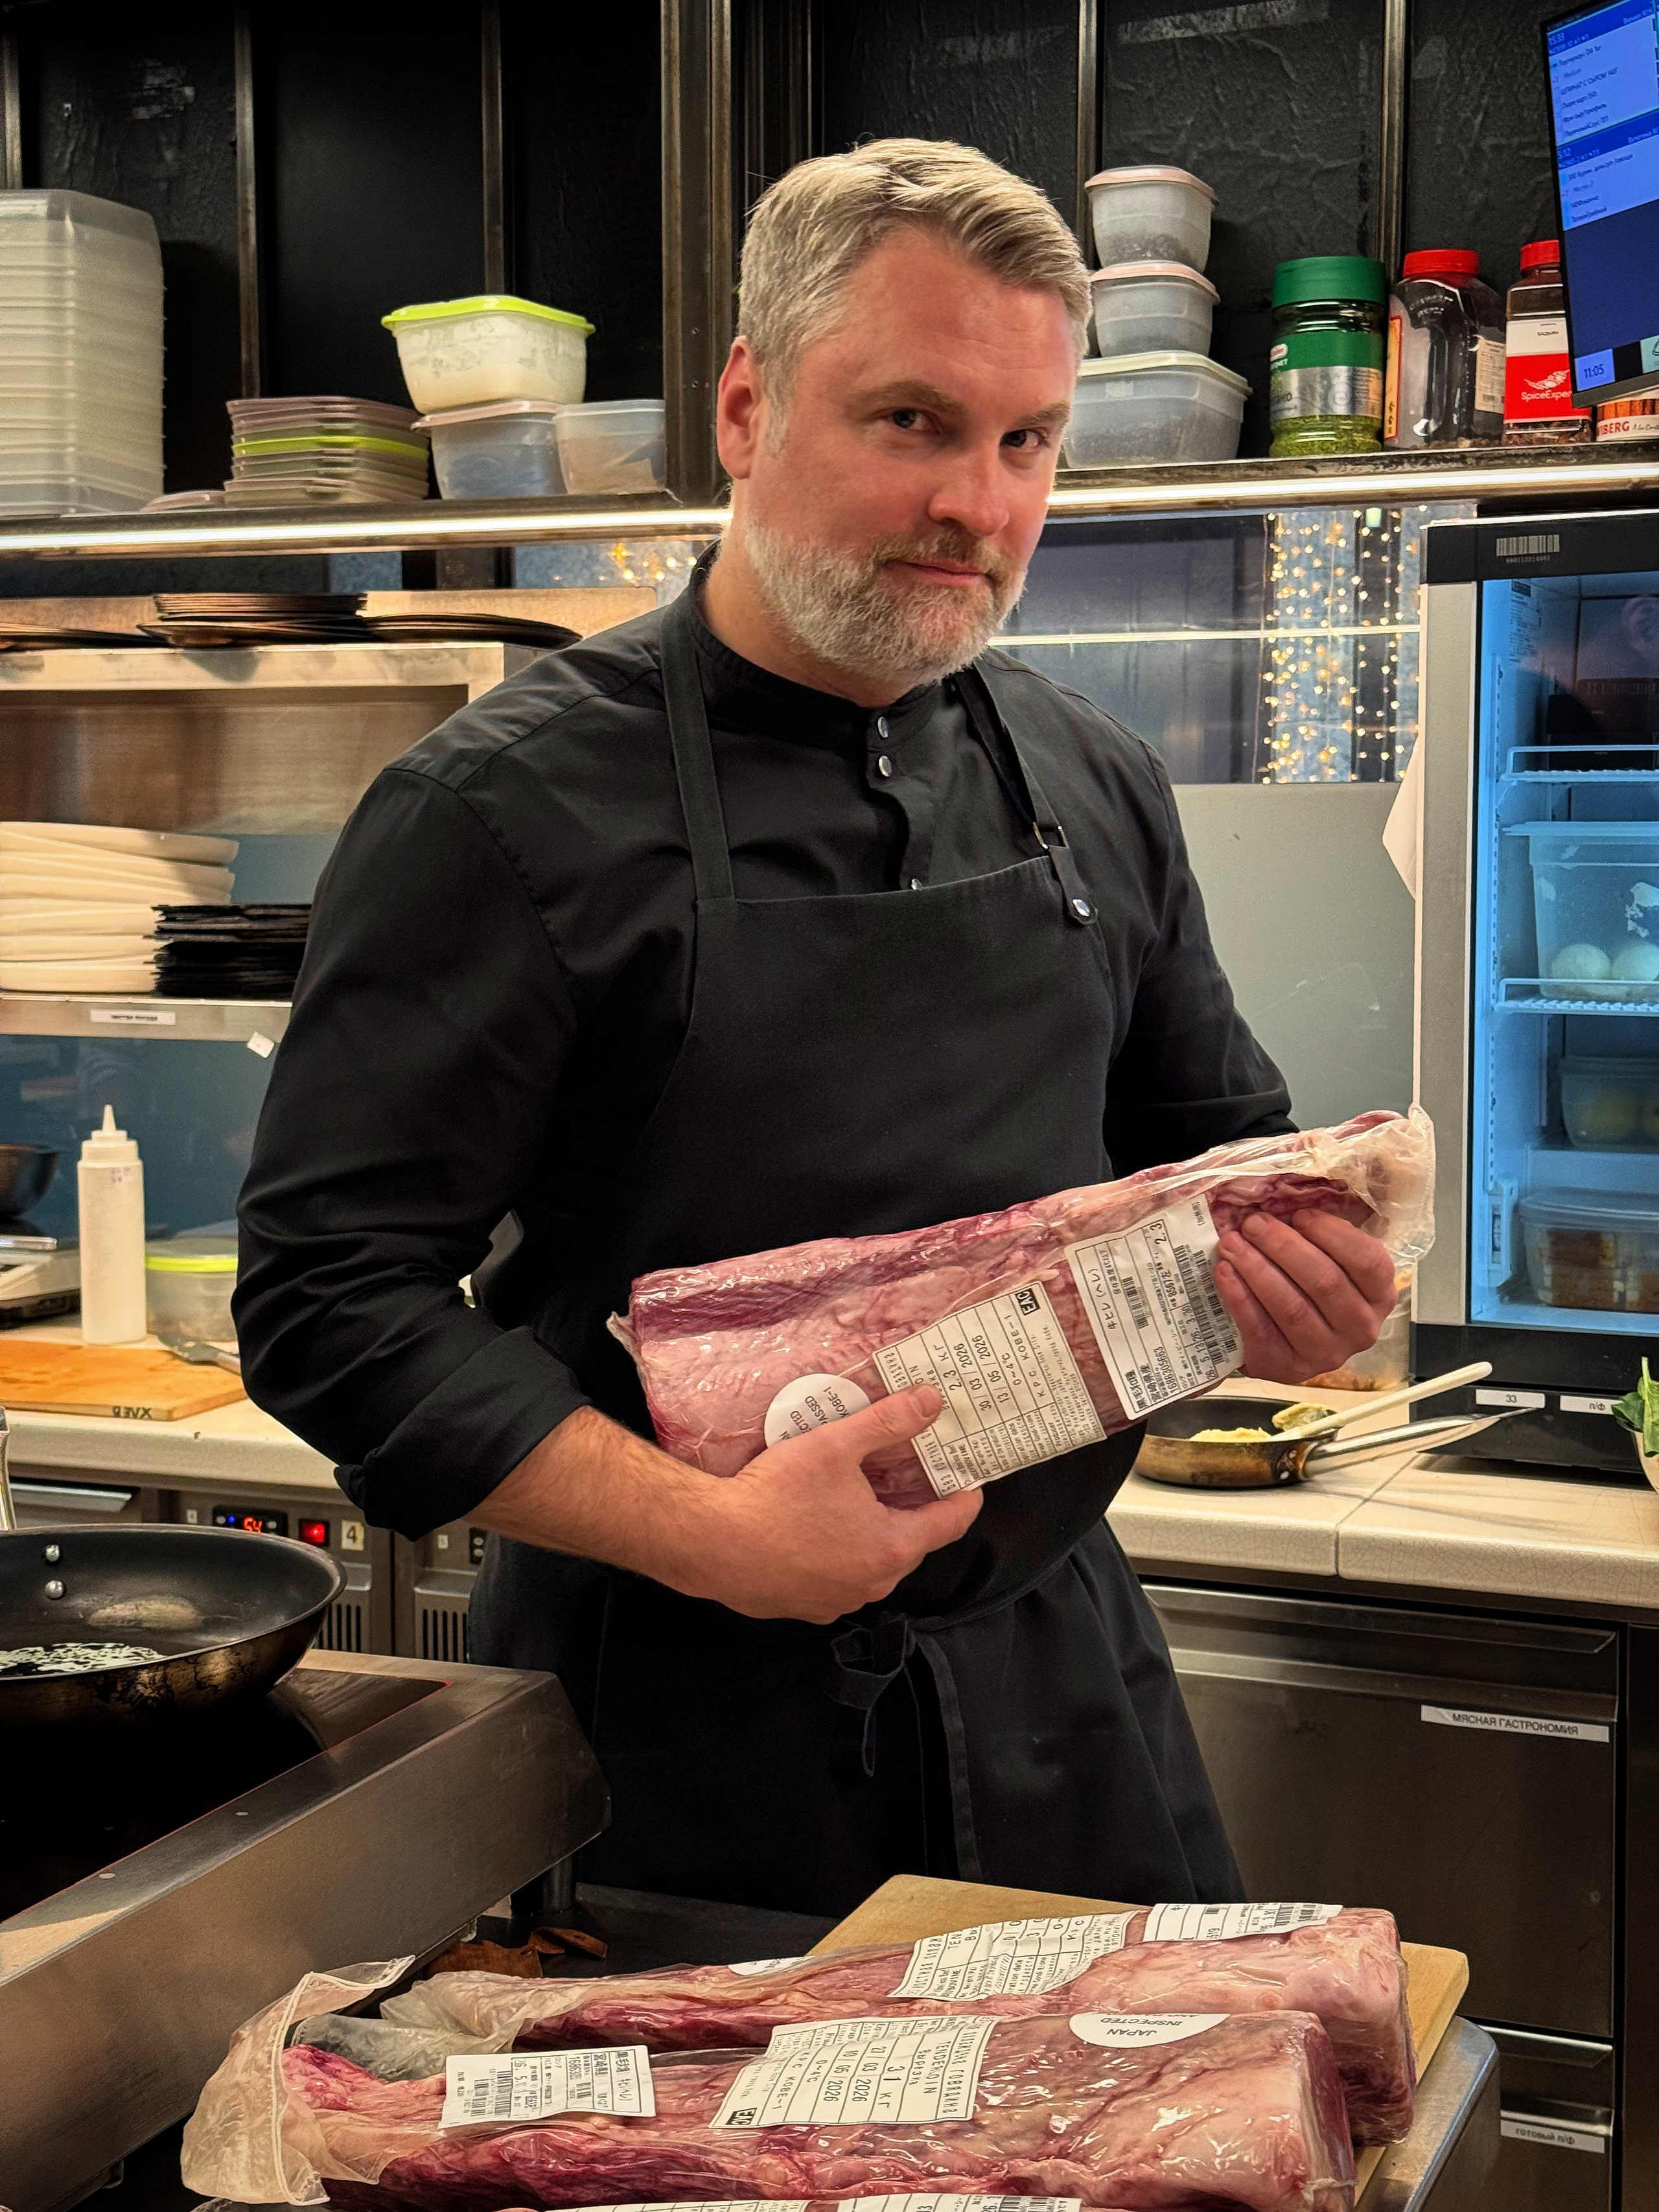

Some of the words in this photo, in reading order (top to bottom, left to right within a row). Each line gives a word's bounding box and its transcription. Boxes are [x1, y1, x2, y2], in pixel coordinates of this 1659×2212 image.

[1520, 390, 1573, 402] SpiceExper
[1017, 1289, 1037, 1313] EAC
[953, 1343, 973, 1368] 2026
[971, 1334, 991, 1360] 2026
[942, 1369, 962, 1391] 2.3
[789, 1410, 811, 1434] ECTED
[346, 1524, 358, 1544] 4
[1452, 1713, 1496, 1726] МЯСНАЯ
[1498, 1717, 1579, 1734] ГАСТРОНОМИЯ
[1106, 2028, 1157, 2036] JAPAN
[822, 2080, 843, 2102] 2026
[852, 2078, 871, 2102] 2026
